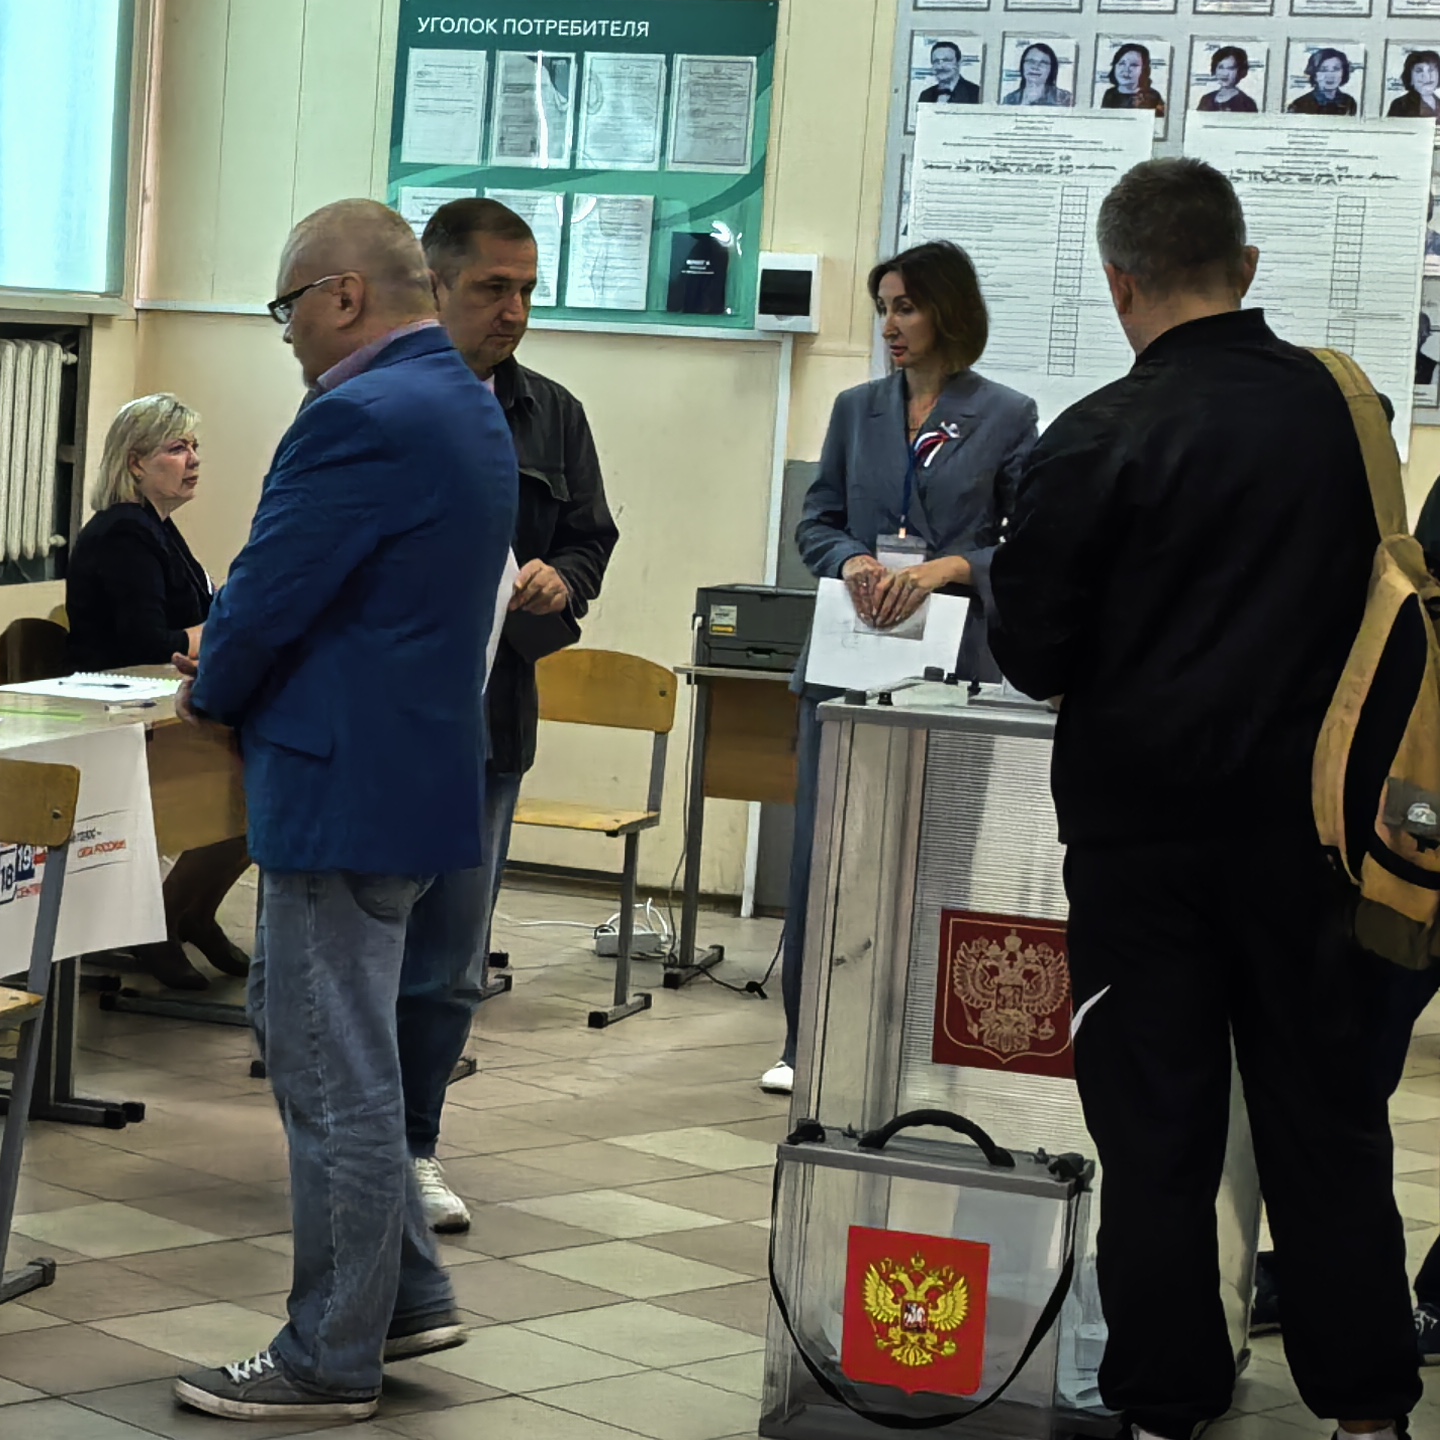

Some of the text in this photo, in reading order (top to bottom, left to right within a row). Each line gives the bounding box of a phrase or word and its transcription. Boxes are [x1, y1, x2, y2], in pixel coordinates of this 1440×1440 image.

[417, 16, 650, 38] УГОЛОК ПОТРЕБИТЕЛЯ
[1, 863, 14, 893] 18
